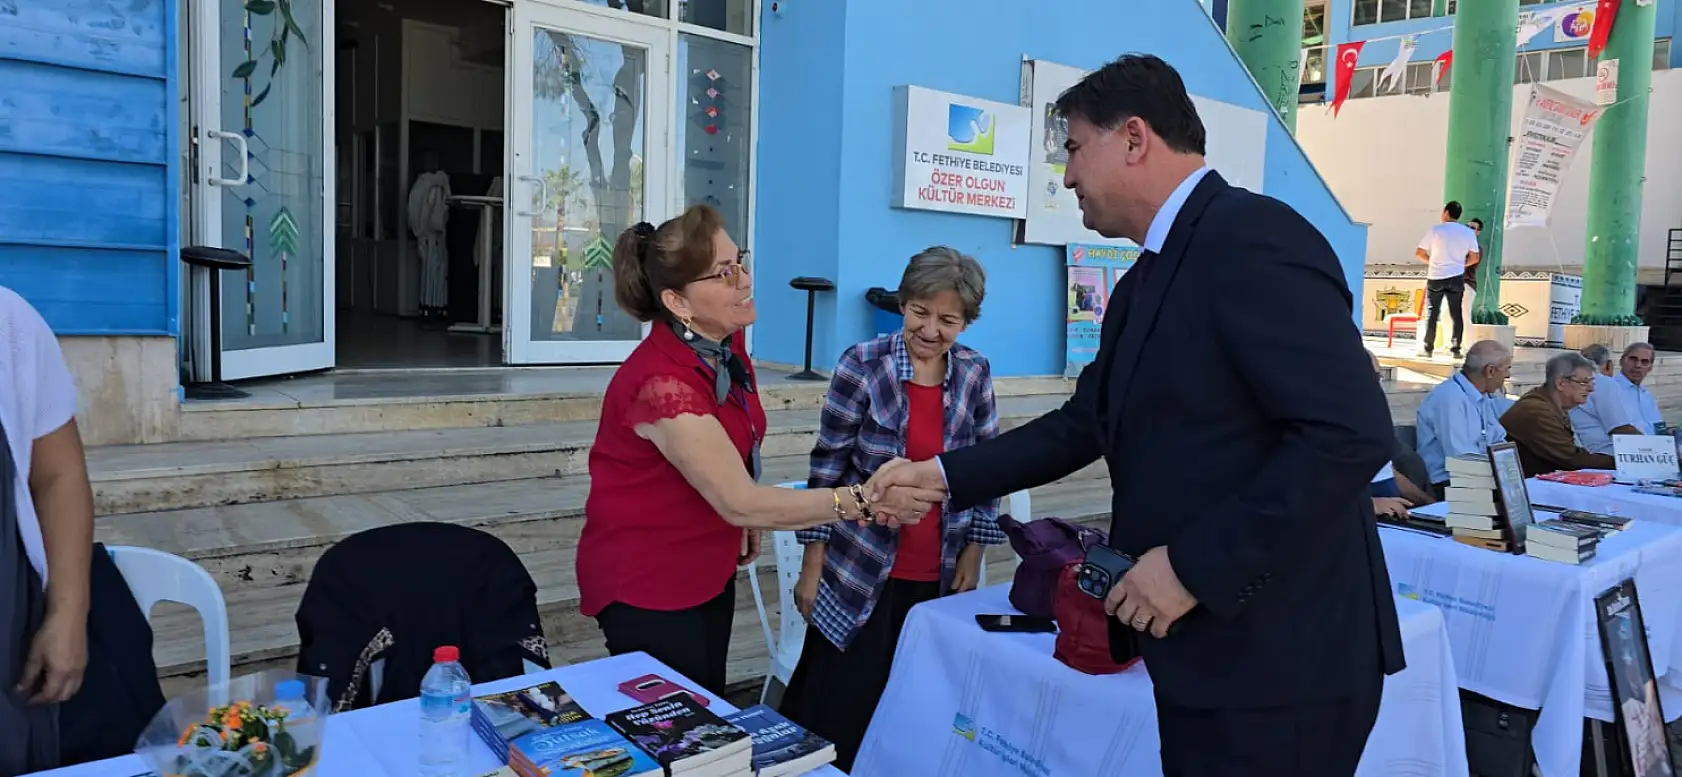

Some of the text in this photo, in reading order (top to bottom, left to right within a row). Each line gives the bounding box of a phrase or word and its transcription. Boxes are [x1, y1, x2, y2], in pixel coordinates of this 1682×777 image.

[913, 151, 1024, 177] T.C. FETHİYE BELEDİYESİ
[931, 168, 1006, 193] ÖZER OLGUN
[918, 184, 1016, 210] KÜLTÜR MERKEZİ
[1617, 453, 1655, 465] TURHAN
